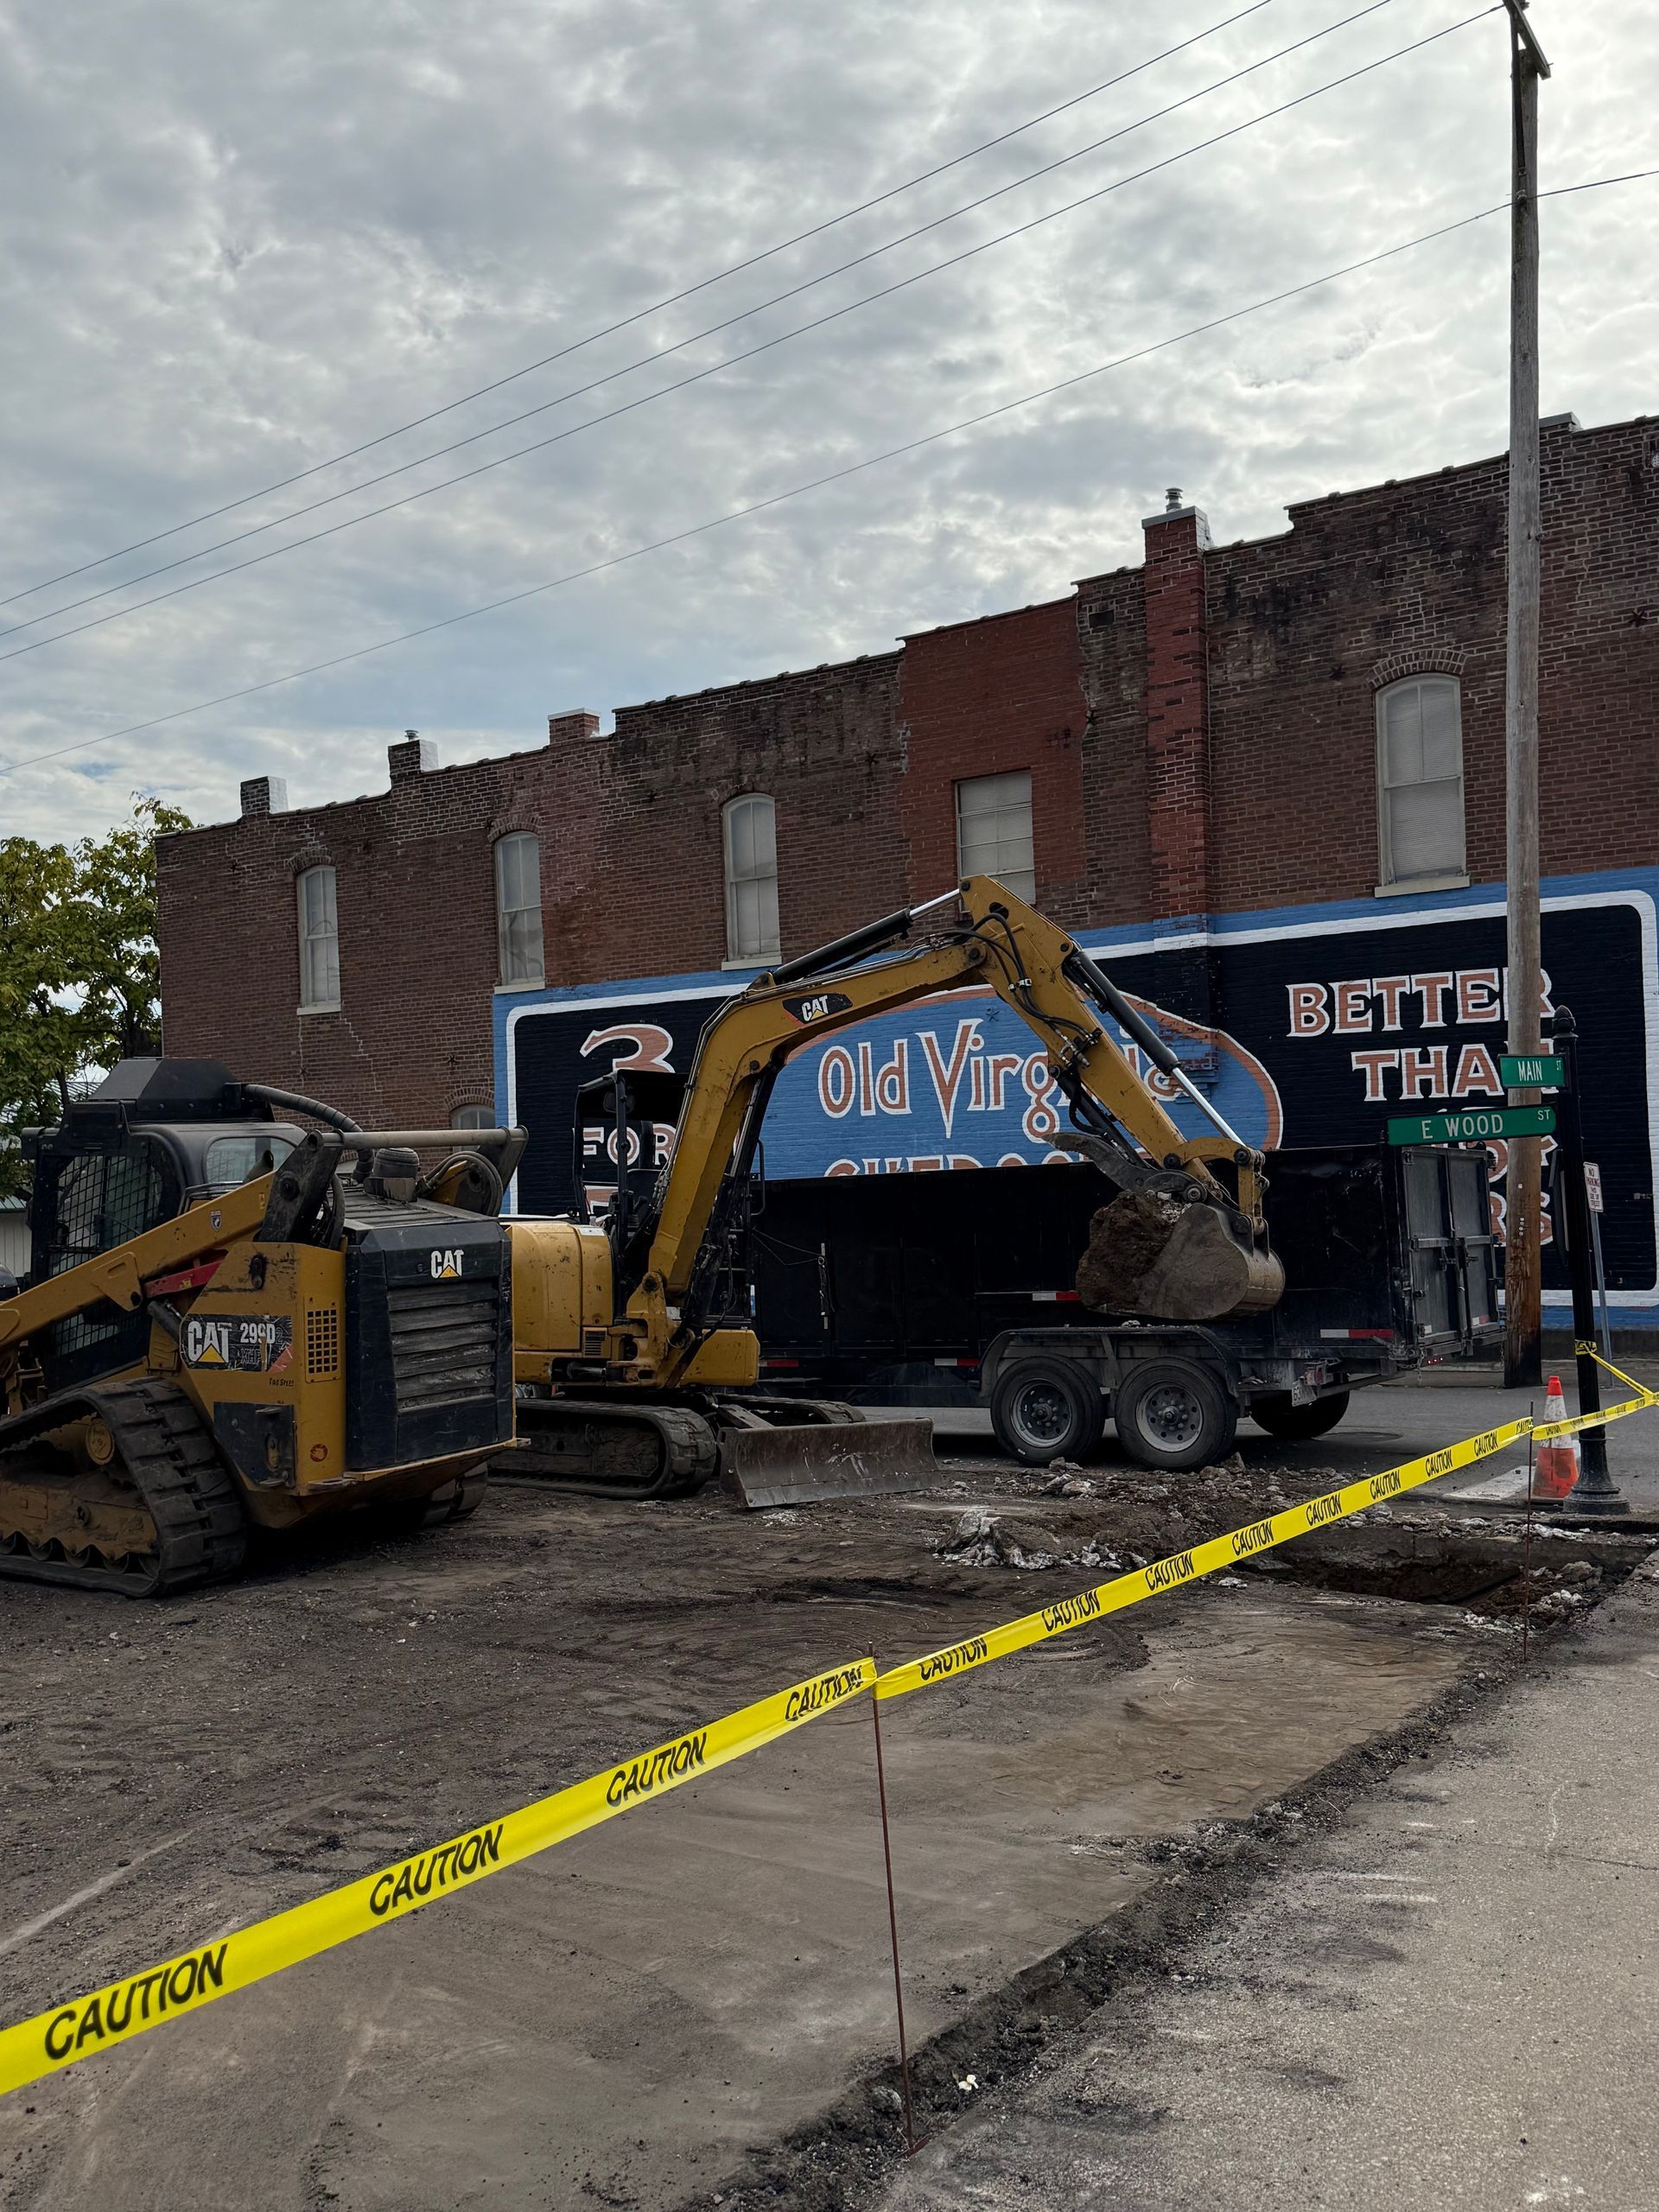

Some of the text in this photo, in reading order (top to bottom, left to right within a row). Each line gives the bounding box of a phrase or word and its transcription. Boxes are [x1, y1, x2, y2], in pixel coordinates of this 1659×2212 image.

[802, 995, 829, 1021] CAT
[818, 1038, 912, 1118] Old
[1351, 1038, 1559, 1102] THA
[1518, 1059, 1561, 1082] MAIN ST
[1421, 1109, 1550, 1140] E WOOD ST
[431, 1249, 464, 1279] CAT
[188, 1320, 232, 1363] CAT
[1424, 1448, 1453, 1478] CAUTION
[1474, 1431, 1498, 1457] CAUTION
[1370, 1469, 1402, 1501] CAUTION
[1306, 1493, 1343, 1528] CAUTION
[1232, 1520, 1274, 1557] CAUTION
[1145, 1551, 1195, 1591] CAUTION
[1041, 1589, 1101, 1631] CAUTION
[919, 1637, 988, 1681] CAUTION
[785, 1664, 863, 1722] CAUTION
[606, 1732, 707, 1808] CAUTION
[369, 1824, 504, 1916] CAUTION
[45, 1942, 228, 2060] CAUTION
